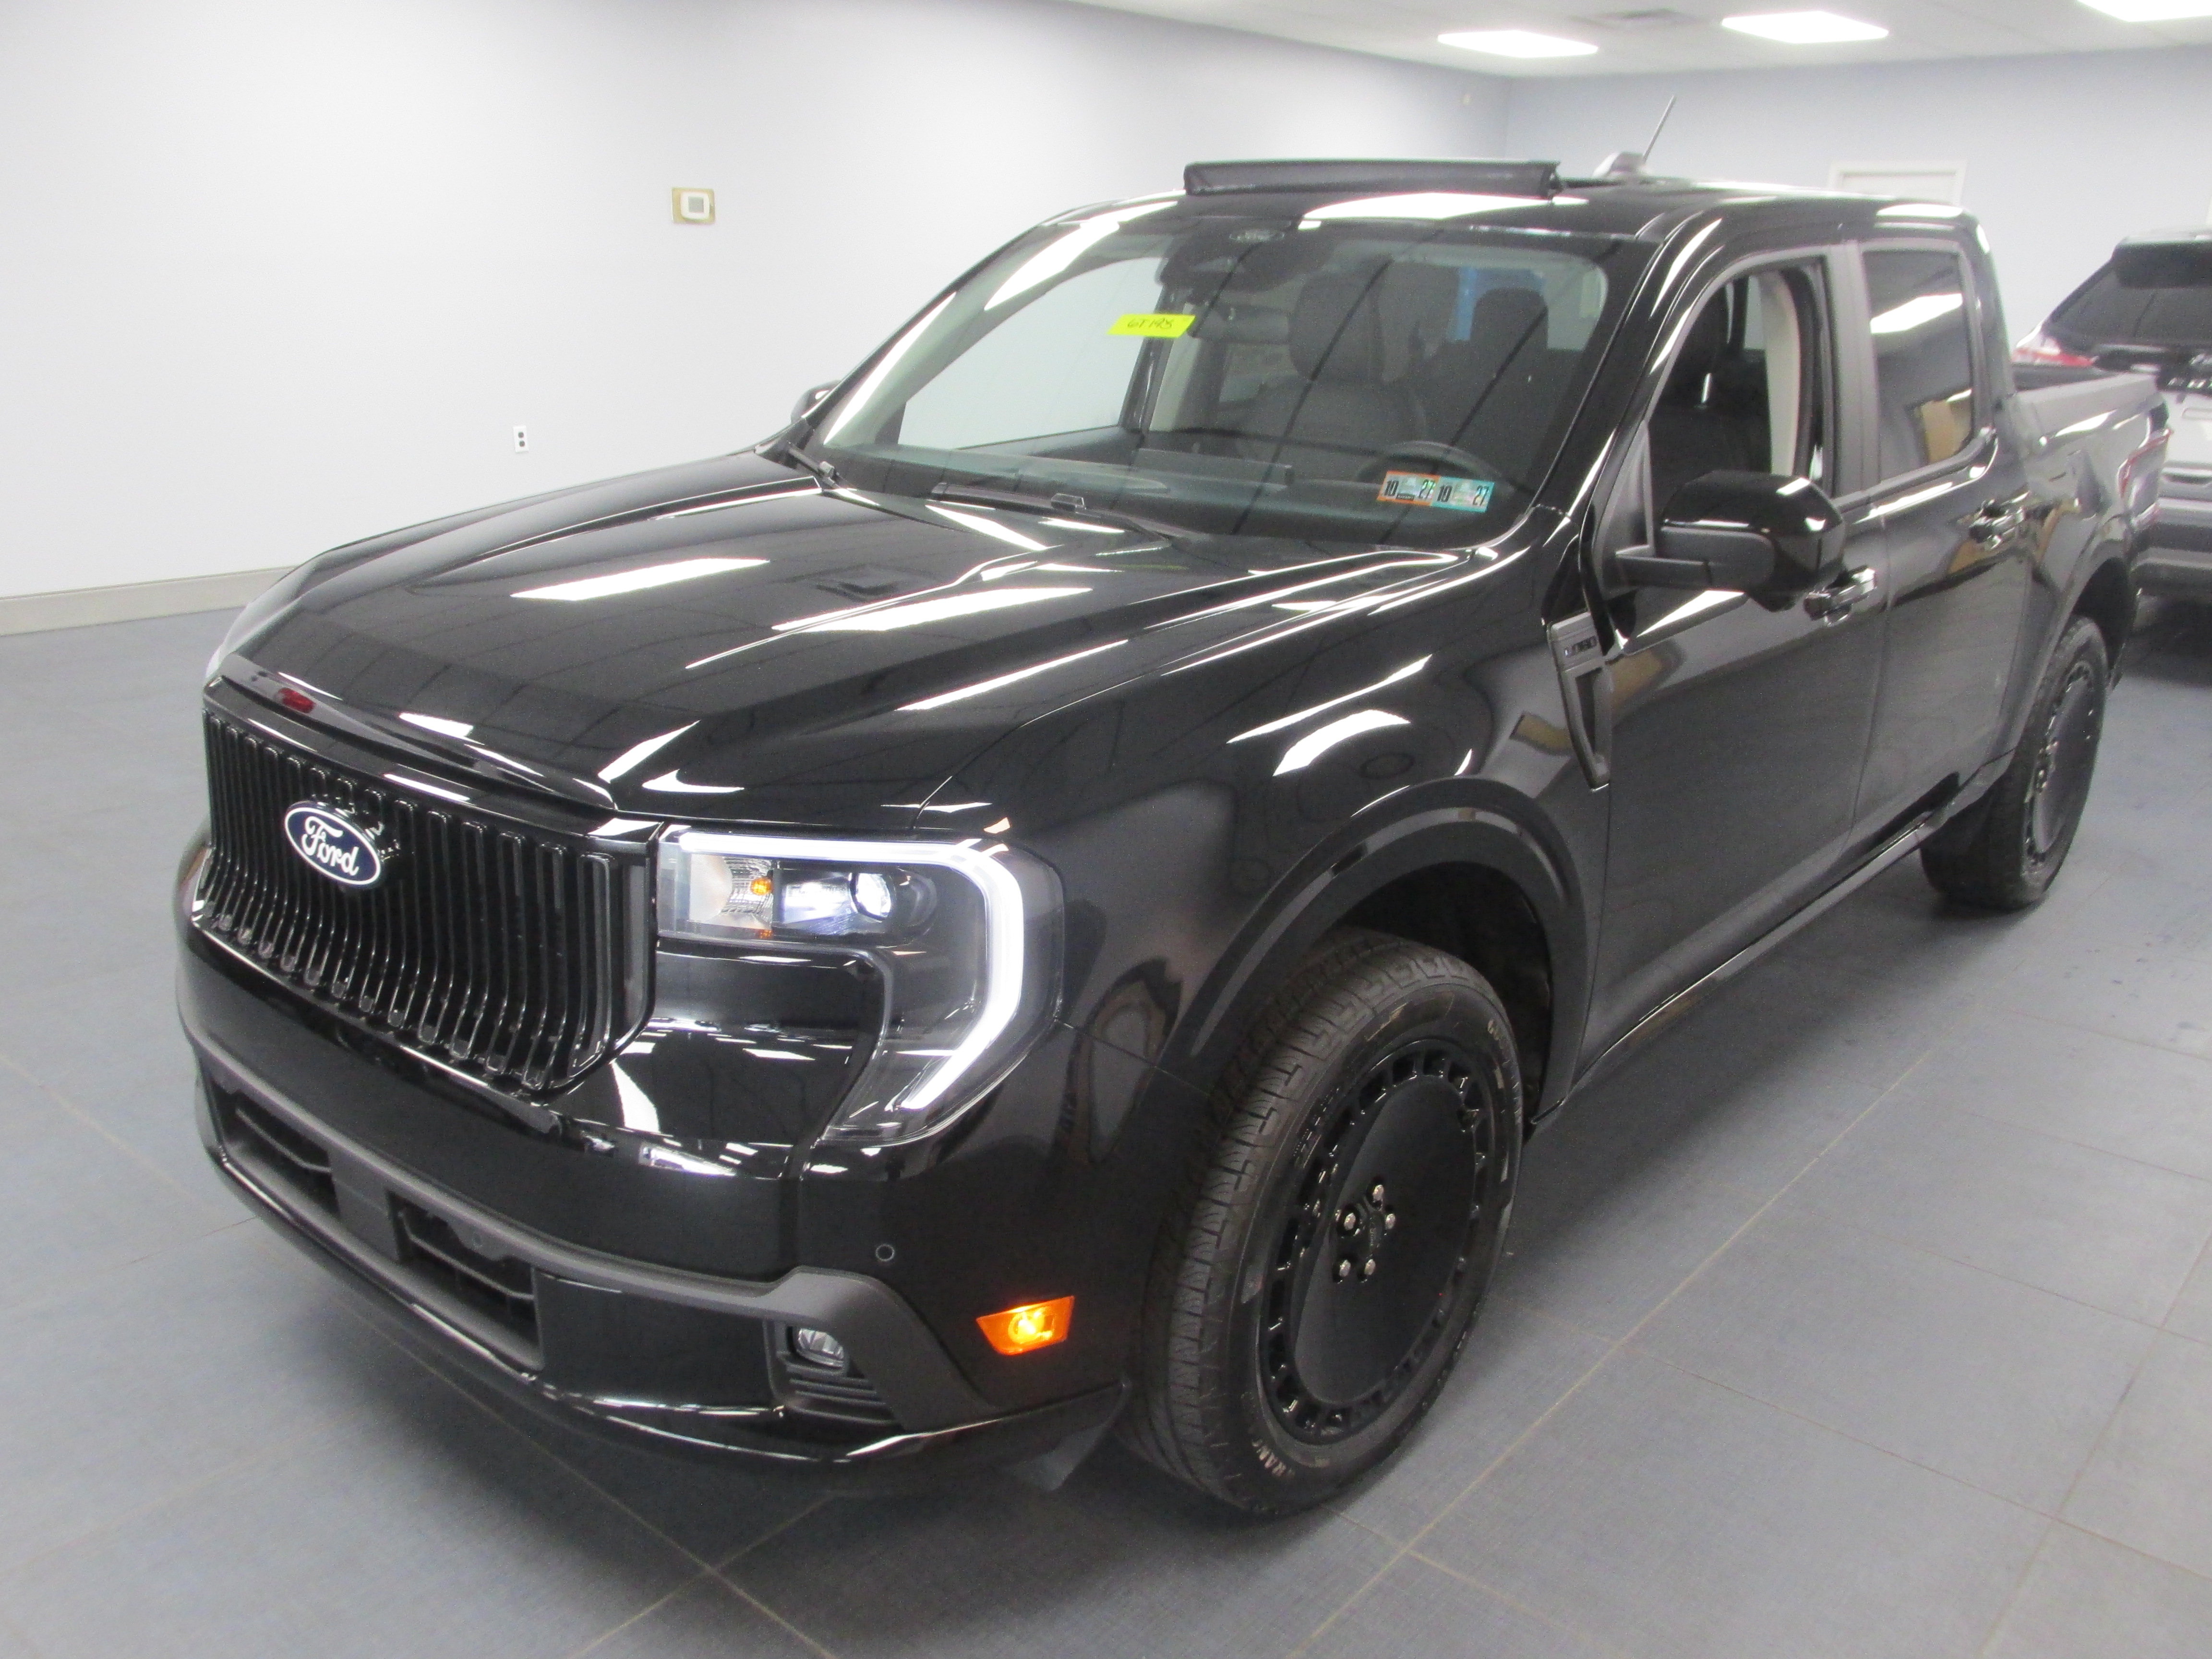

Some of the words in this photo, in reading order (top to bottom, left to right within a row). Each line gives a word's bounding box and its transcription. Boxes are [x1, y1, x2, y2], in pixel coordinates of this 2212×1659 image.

[1384, 480, 1399, 497] 10
[1418, 479, 1436, 500] 27
[1436, 484, 1453, 503] 10
[1472, 485, 1490, 506] 27
[301, 816, 360, 876] Ford
